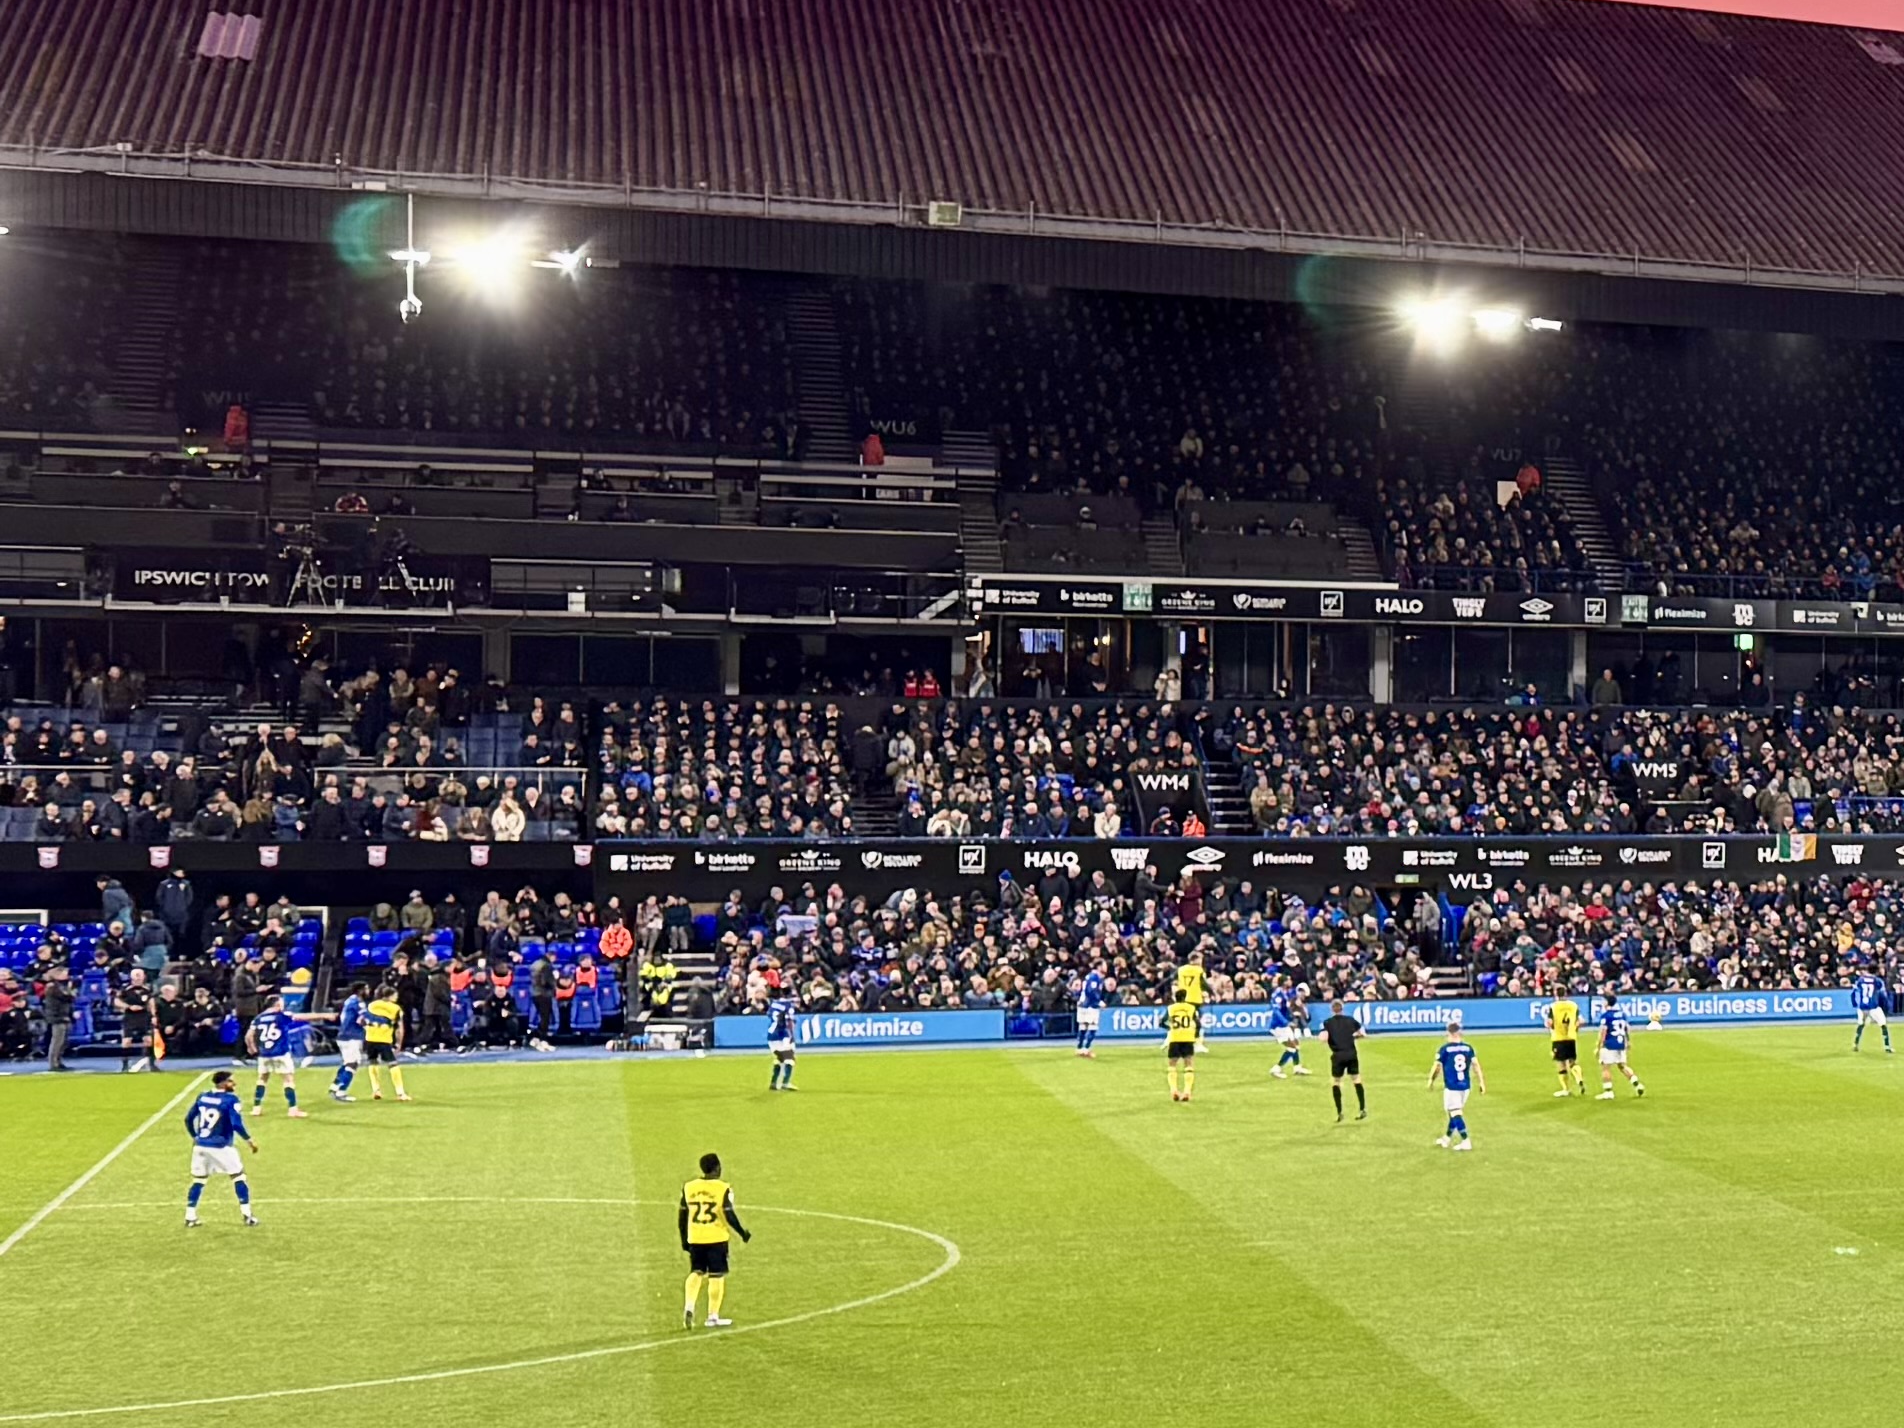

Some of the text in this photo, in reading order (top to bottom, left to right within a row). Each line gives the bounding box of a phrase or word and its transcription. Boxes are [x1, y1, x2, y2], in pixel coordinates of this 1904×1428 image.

[1376, 598, 1424, 613] HALO
[1632, 762, 1678, 778] WM5
[1138, 774, 1189, 790] WM4
[1024, 851, 1079, 868] HALO
[1449, 873, 1493, 889] WL3
[1677, 995, 1768, 1016] Business
[1773, 994, 1833, 1013] Loans
[1172, 1015, 1190, 1029] 50
[1374, 1005, 1463, 1024] fleximize
[1562, 1012, 1570, 1024] 4
[257, 1023, 282, 1042] 26
[825, 1017, 923, 1039] fleximize
[1453, 1053, 1467, 1072] 8
[198, 1105, 220, 1130] 19
[688, 1201, 718, 1224] 23
